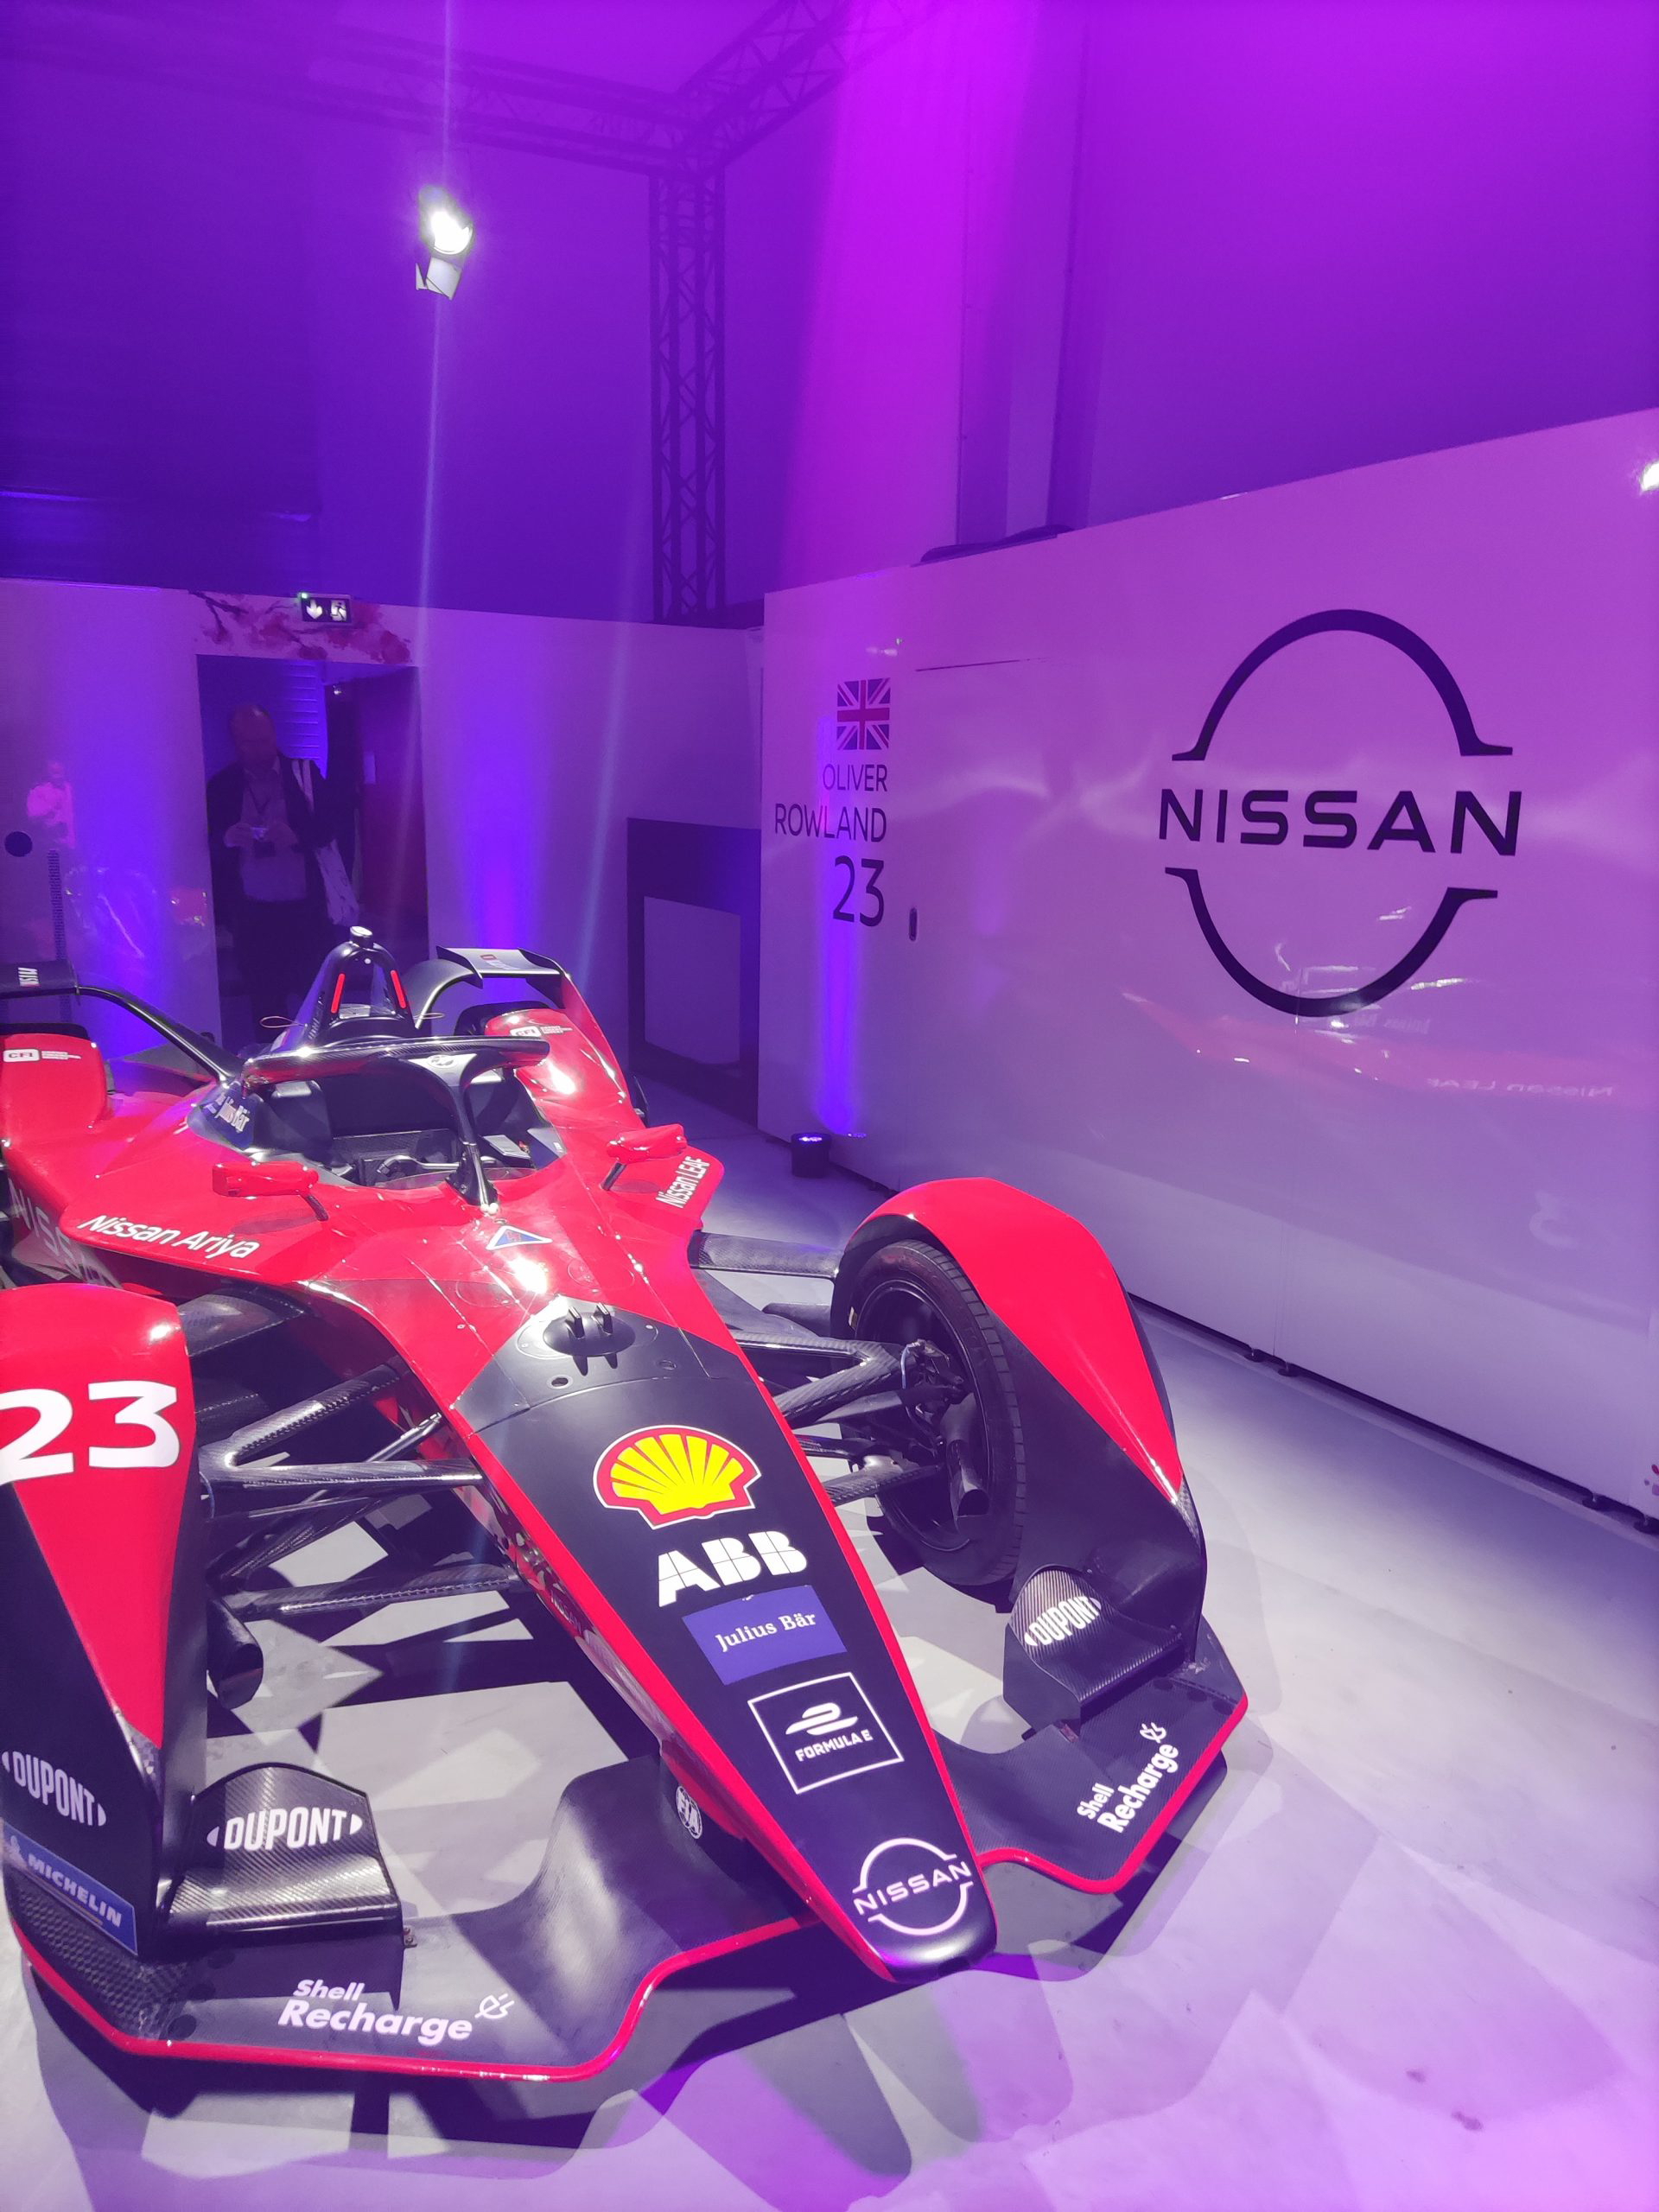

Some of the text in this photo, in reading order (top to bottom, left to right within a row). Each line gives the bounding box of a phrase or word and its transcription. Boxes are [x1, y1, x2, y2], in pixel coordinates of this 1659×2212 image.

[823, 764, 887, 792] OLIVER
[774, 803, 887, 843] ROWLAND
[1159, 788, 1522, 856] NISSAN
[832, 855, 885, 927] 23
[655, 1156, 710, 1209] Nissan LEAF
[77, 1215, 260, 1259] Nissan Ariya
[0, 1380, 180, 1486] 23
[658, 1530, 807, 1606] ABB
[715, 1611, 817, 1653] Julius Bär
[1028, 1595, 1099, 1646] DUPONT
[794, 1729, 874, 1762] FORMULA E
[12, 1751, 95, 1826] DUPONT
[1077, 1783, 1116, 1820] Shell
[1096, 1743, 1179, 1833] Recharge
[224, 1806, 347, 1851] DUPONT
[28, 1853, 122, 1928] MICHELIN
[854, 1860, 973, 1916] NISSAN
[293, 1979, 365, 2003] Shell
[277, 1999, 473, 2045] Recharge
